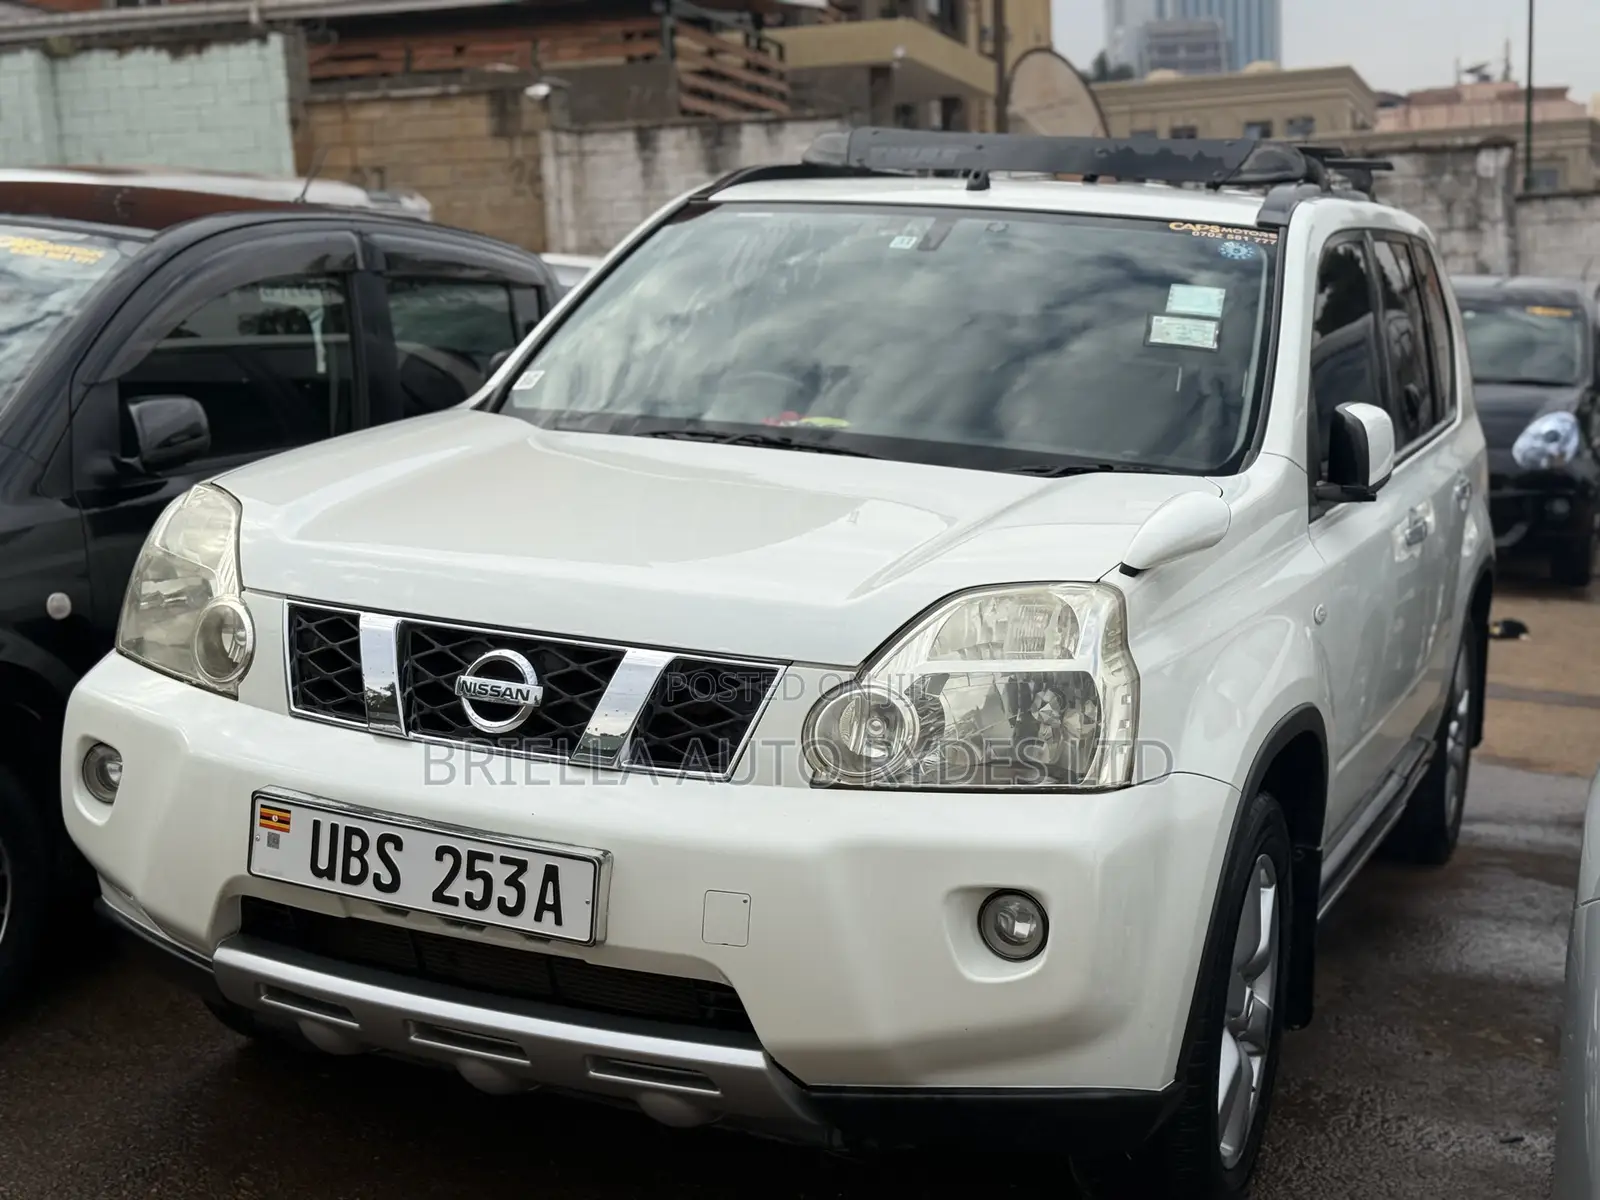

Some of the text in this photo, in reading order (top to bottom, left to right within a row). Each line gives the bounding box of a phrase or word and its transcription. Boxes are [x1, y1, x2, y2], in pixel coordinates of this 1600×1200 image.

[1221, 227, 1278, 239] MOTORS
[1254, 237, 1277, 245] 777
[460, 680, 530, 701] NISSAN
[310, 818, 564, 927] UBS 253A
